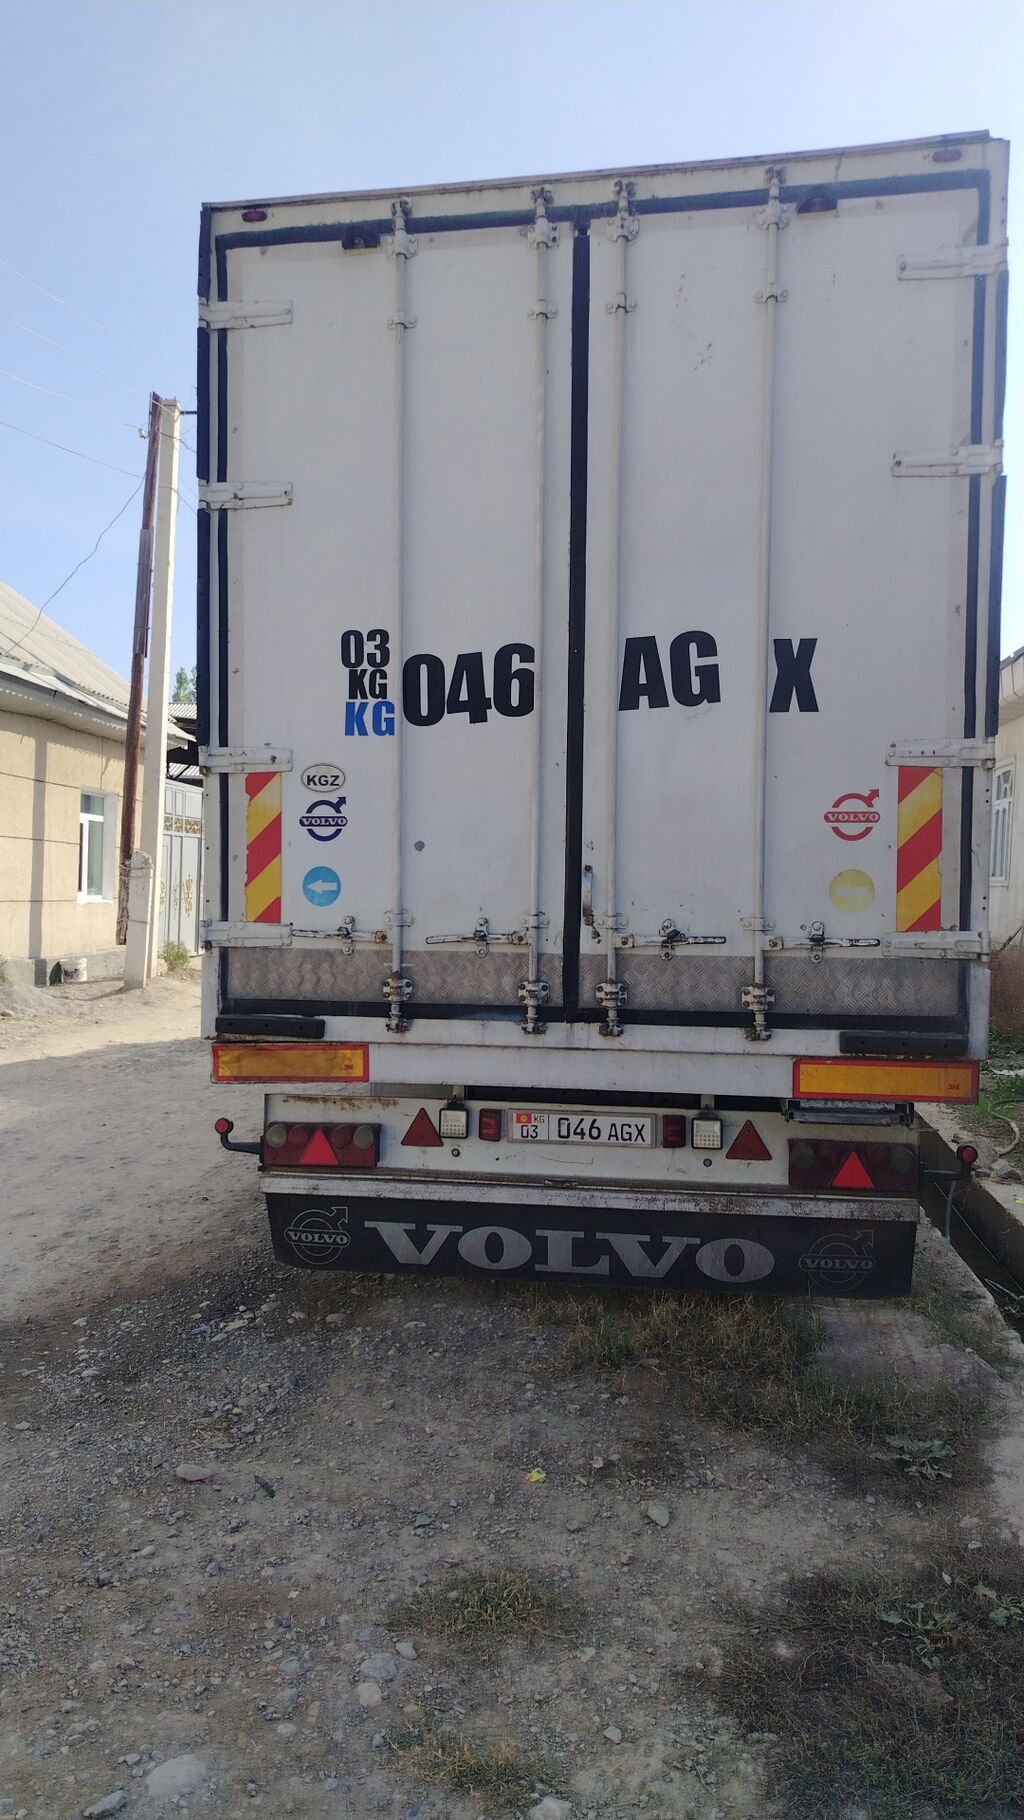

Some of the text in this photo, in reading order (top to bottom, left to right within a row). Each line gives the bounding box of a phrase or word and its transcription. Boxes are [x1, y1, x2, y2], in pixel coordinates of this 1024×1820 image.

[340, 629, 390, 668] 03
[348, 669, 387, 700] KG
[402, 630, 819, 727] 046 AG X
[344, 701, 395, 736] KG
[306, 774, 340, 786] KGZ
[301, 817, 347, 826] VOLVO
[827, 813, 880, 821] VOLVO
[533, 1115, 545, 1123] KG
[520, 1117, 646, 1142] 03 046 AGX
[287, 1231, 348, 1244] VOLVO
[364, 1220, 775, 1282] VOLVO
[803, 1258, 873, 1269] VOLVO
